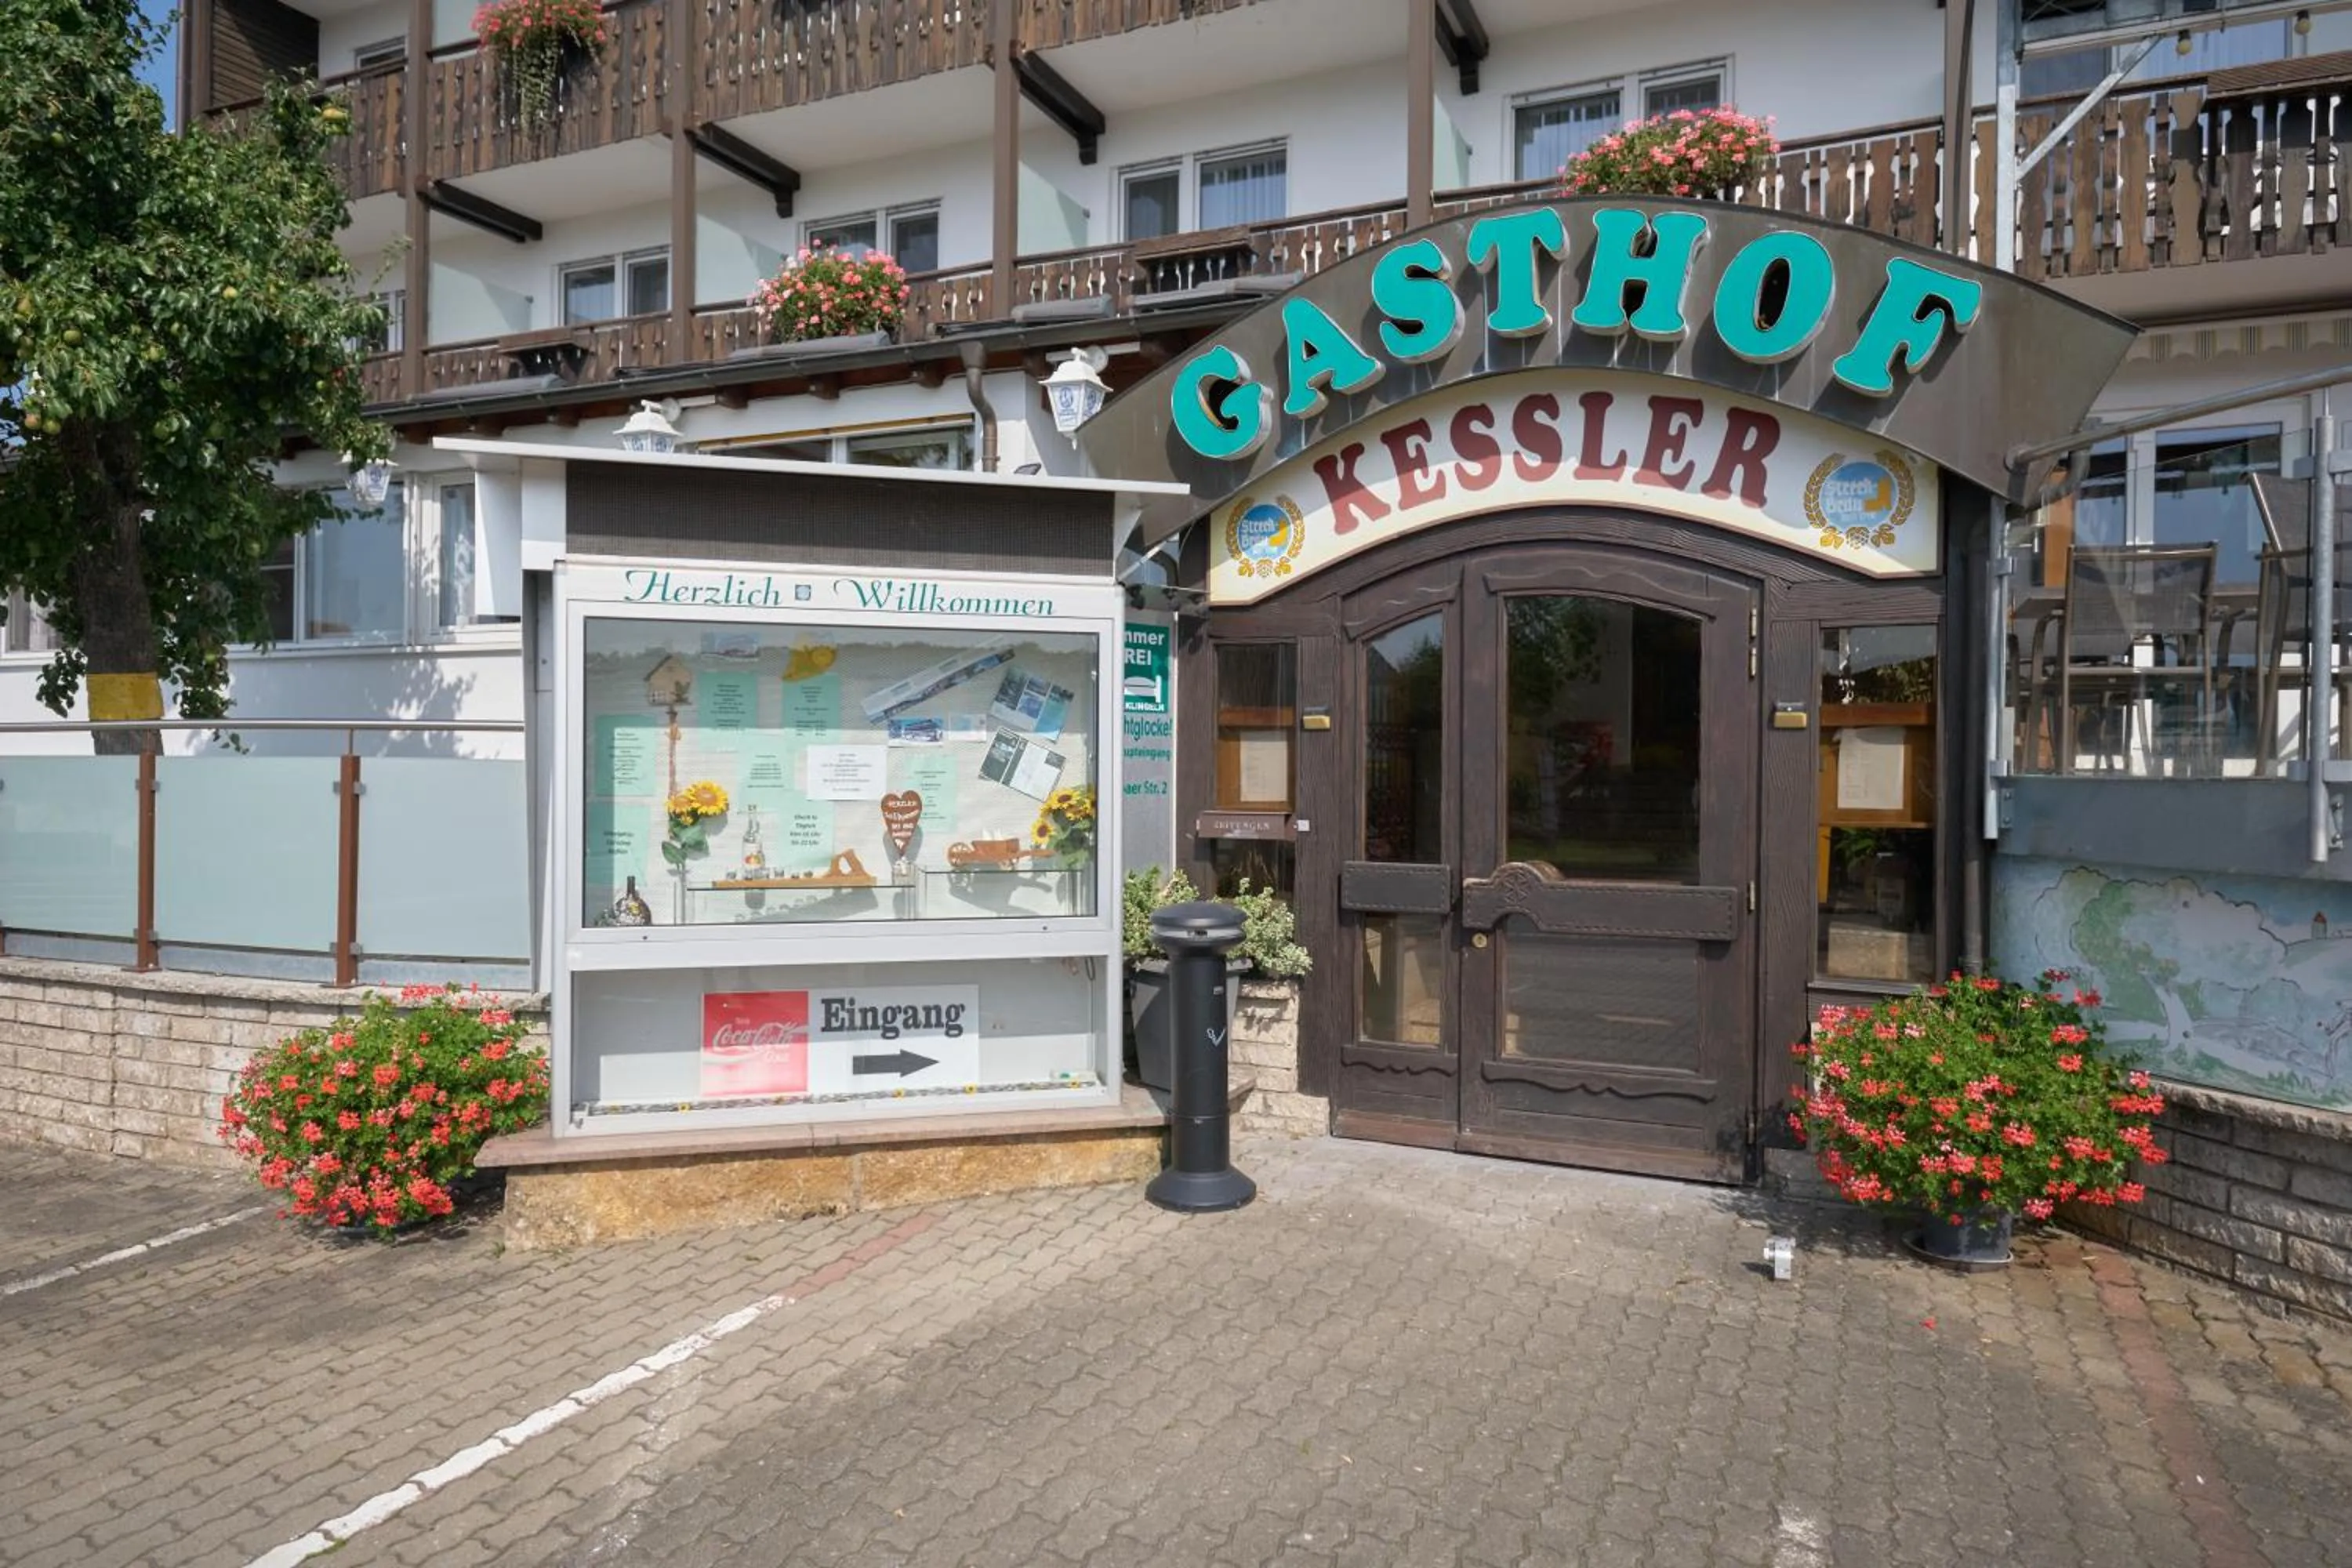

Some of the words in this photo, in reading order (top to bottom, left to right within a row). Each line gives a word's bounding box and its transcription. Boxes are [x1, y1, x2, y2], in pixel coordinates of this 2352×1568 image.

[1171, 207, 1984, 461] GASTHOF
[1312, 391, 1782, 536] KESSLER
[624, 569, 782, 607] Herzlich
[833, 578, 1054, 616] Willkommen
[1124, 648, 1152, 666] REI
[1162, 781, 1167, 794] 2
[820, 996, 966, 1040] Eingang
